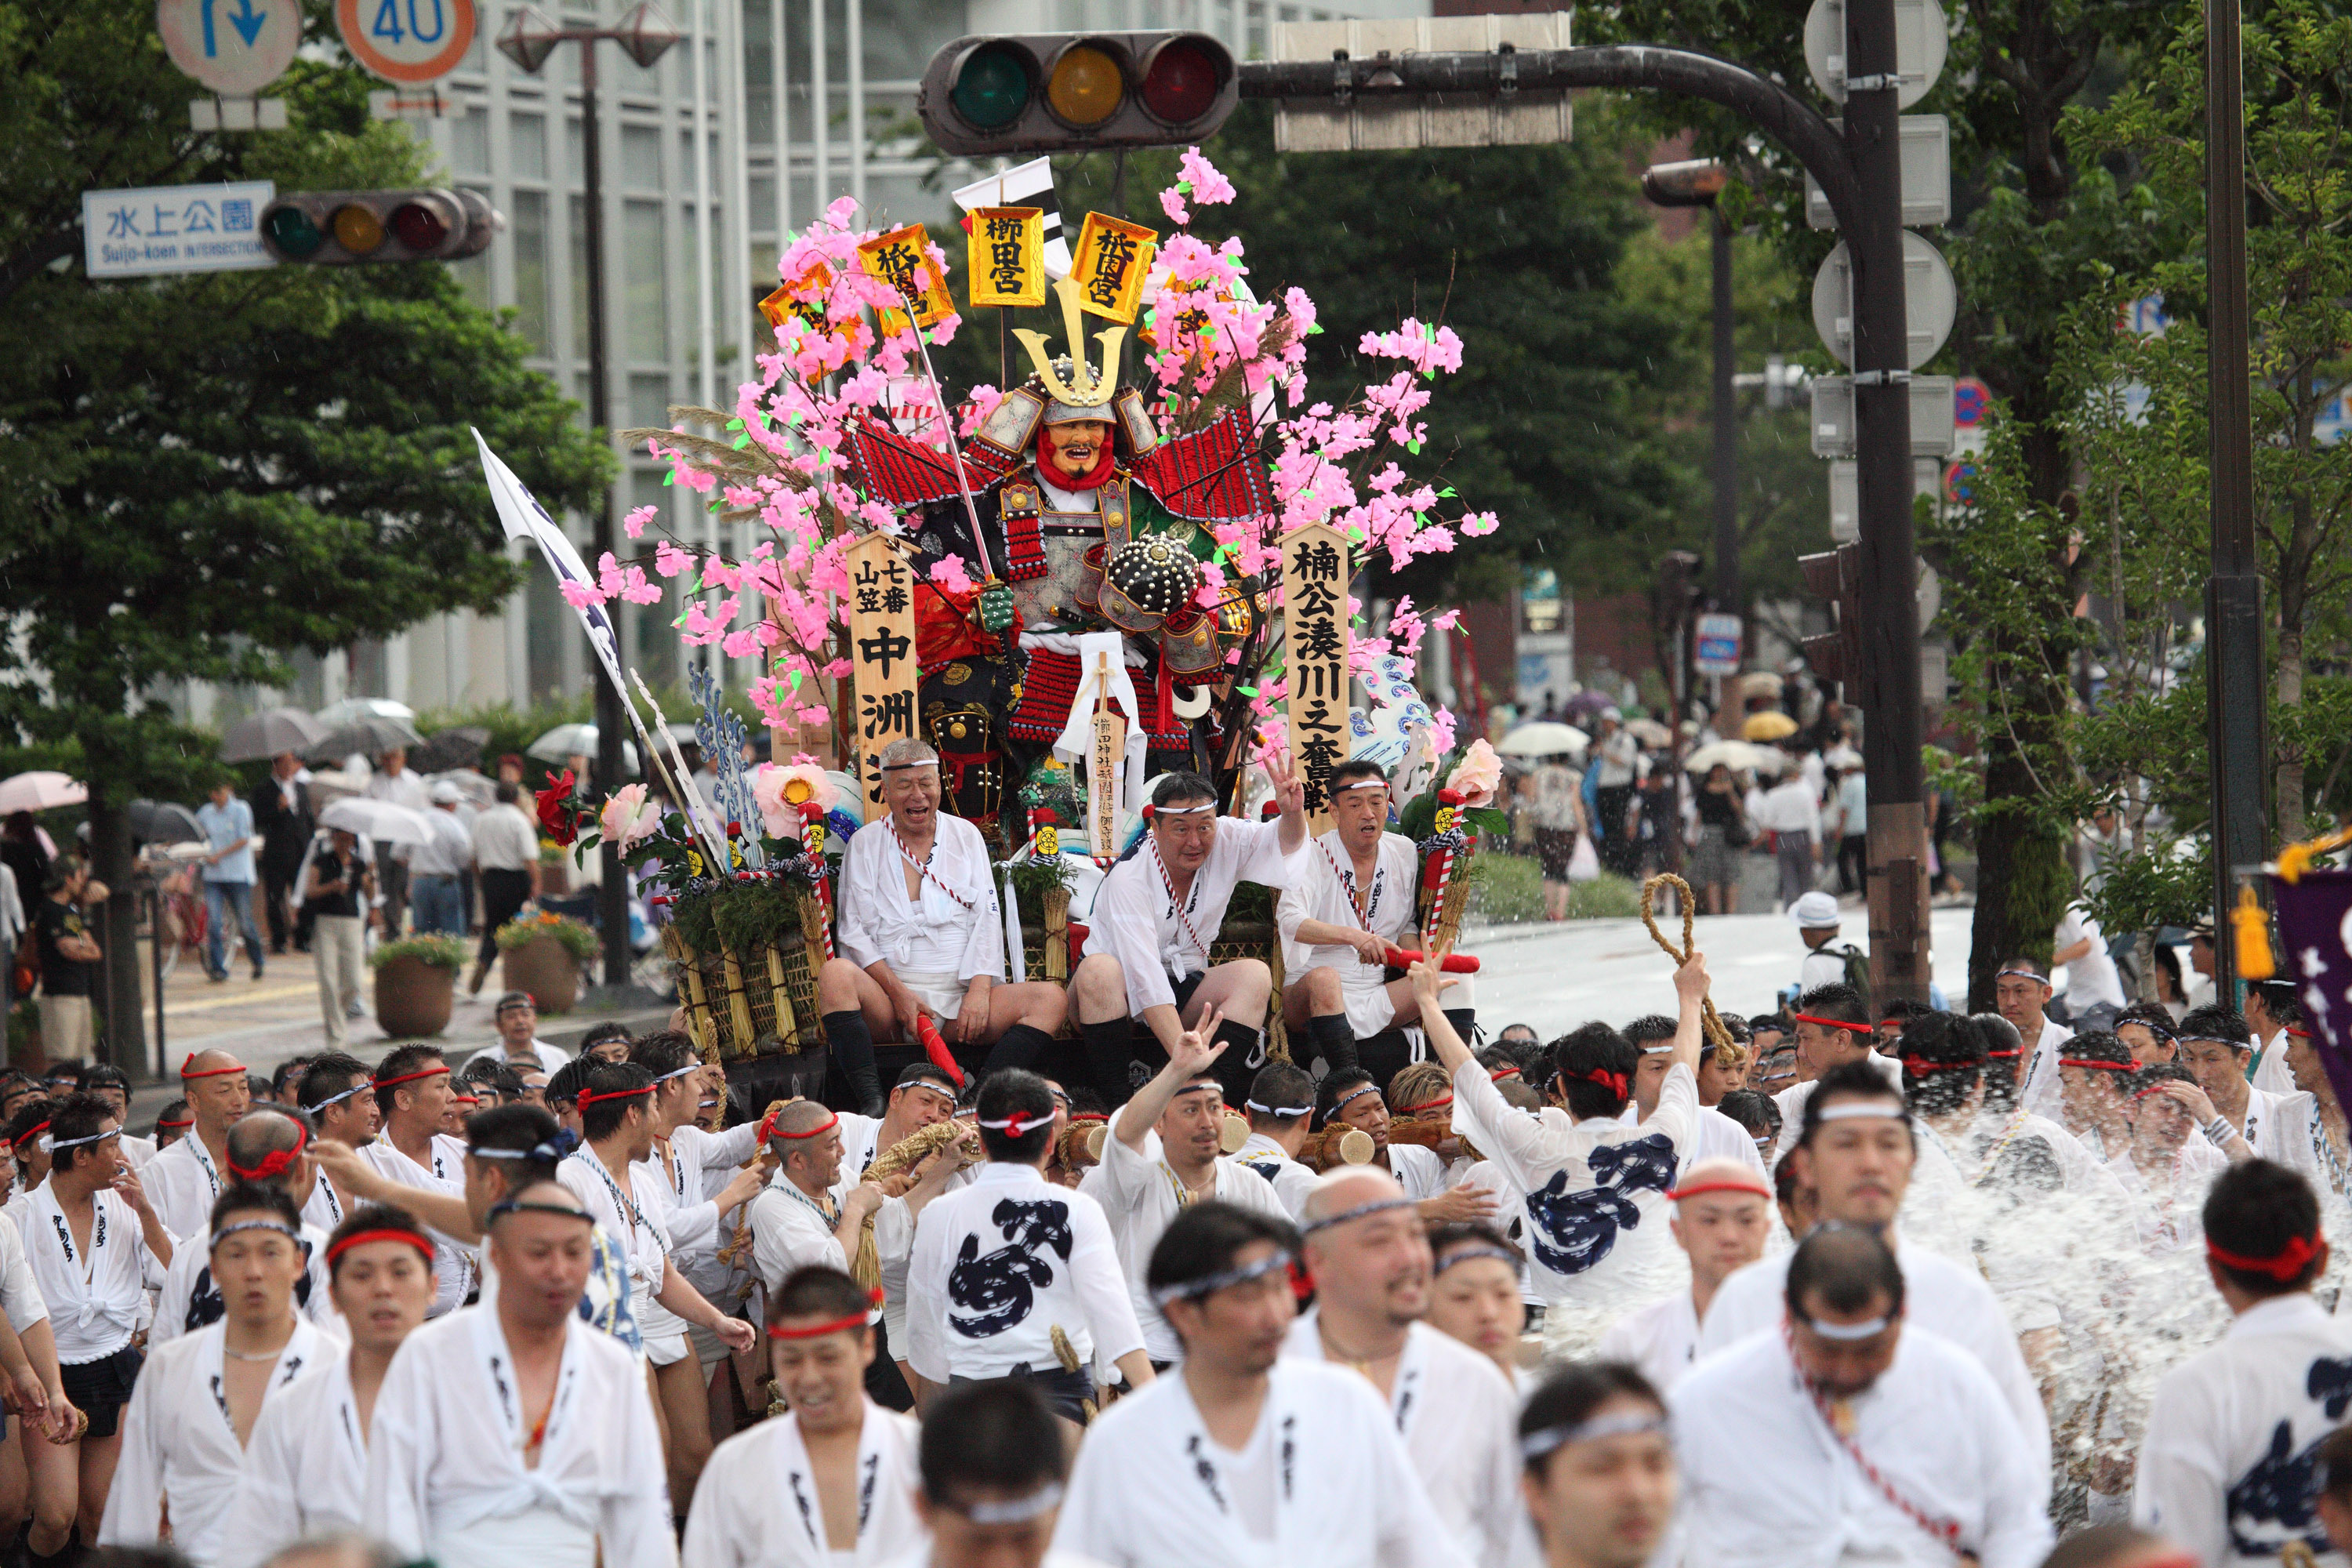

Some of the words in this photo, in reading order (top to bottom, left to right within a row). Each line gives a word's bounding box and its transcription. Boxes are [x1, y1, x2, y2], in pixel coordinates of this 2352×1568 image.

[373, 0, 443, 43] 40
[107, 199, 253, 238] 水上公園
[101, 243, 177, 264] Suijo-koen
[985, 218, 1025, 295] 櫛田宮
[854, 561, 882, 614] 山笠
[880, 559, 909, 614] 七番
